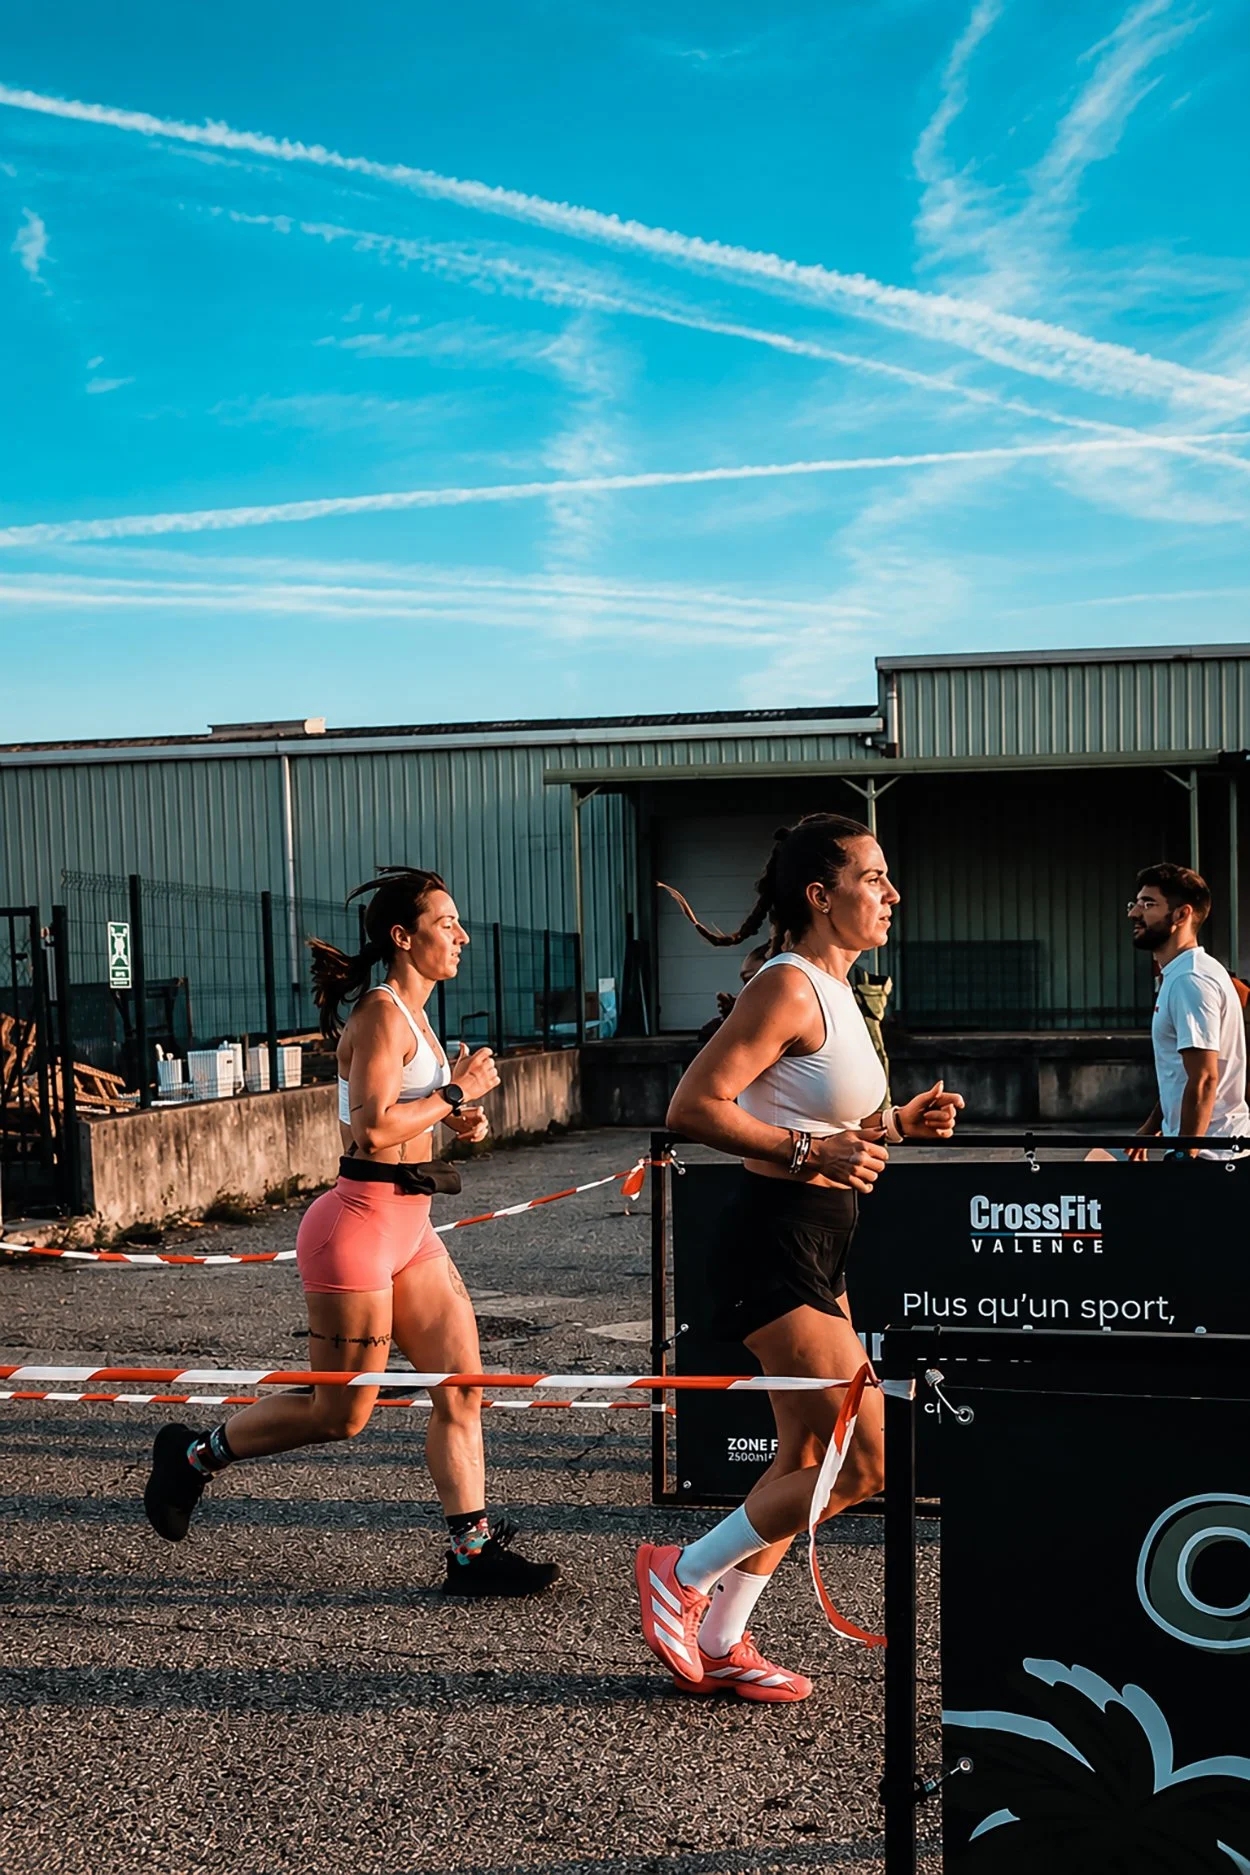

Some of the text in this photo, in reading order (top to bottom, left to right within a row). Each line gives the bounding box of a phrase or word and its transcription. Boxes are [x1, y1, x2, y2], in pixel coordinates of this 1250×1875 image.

[970, 1195, 1102, 1230] CrossFit
[971, 1239, 1103, 1253] VALENCE
[903, 1291, 1176, 1326] Plus qu'un sport,
[727, 1438, 768, 1451] ZONE
